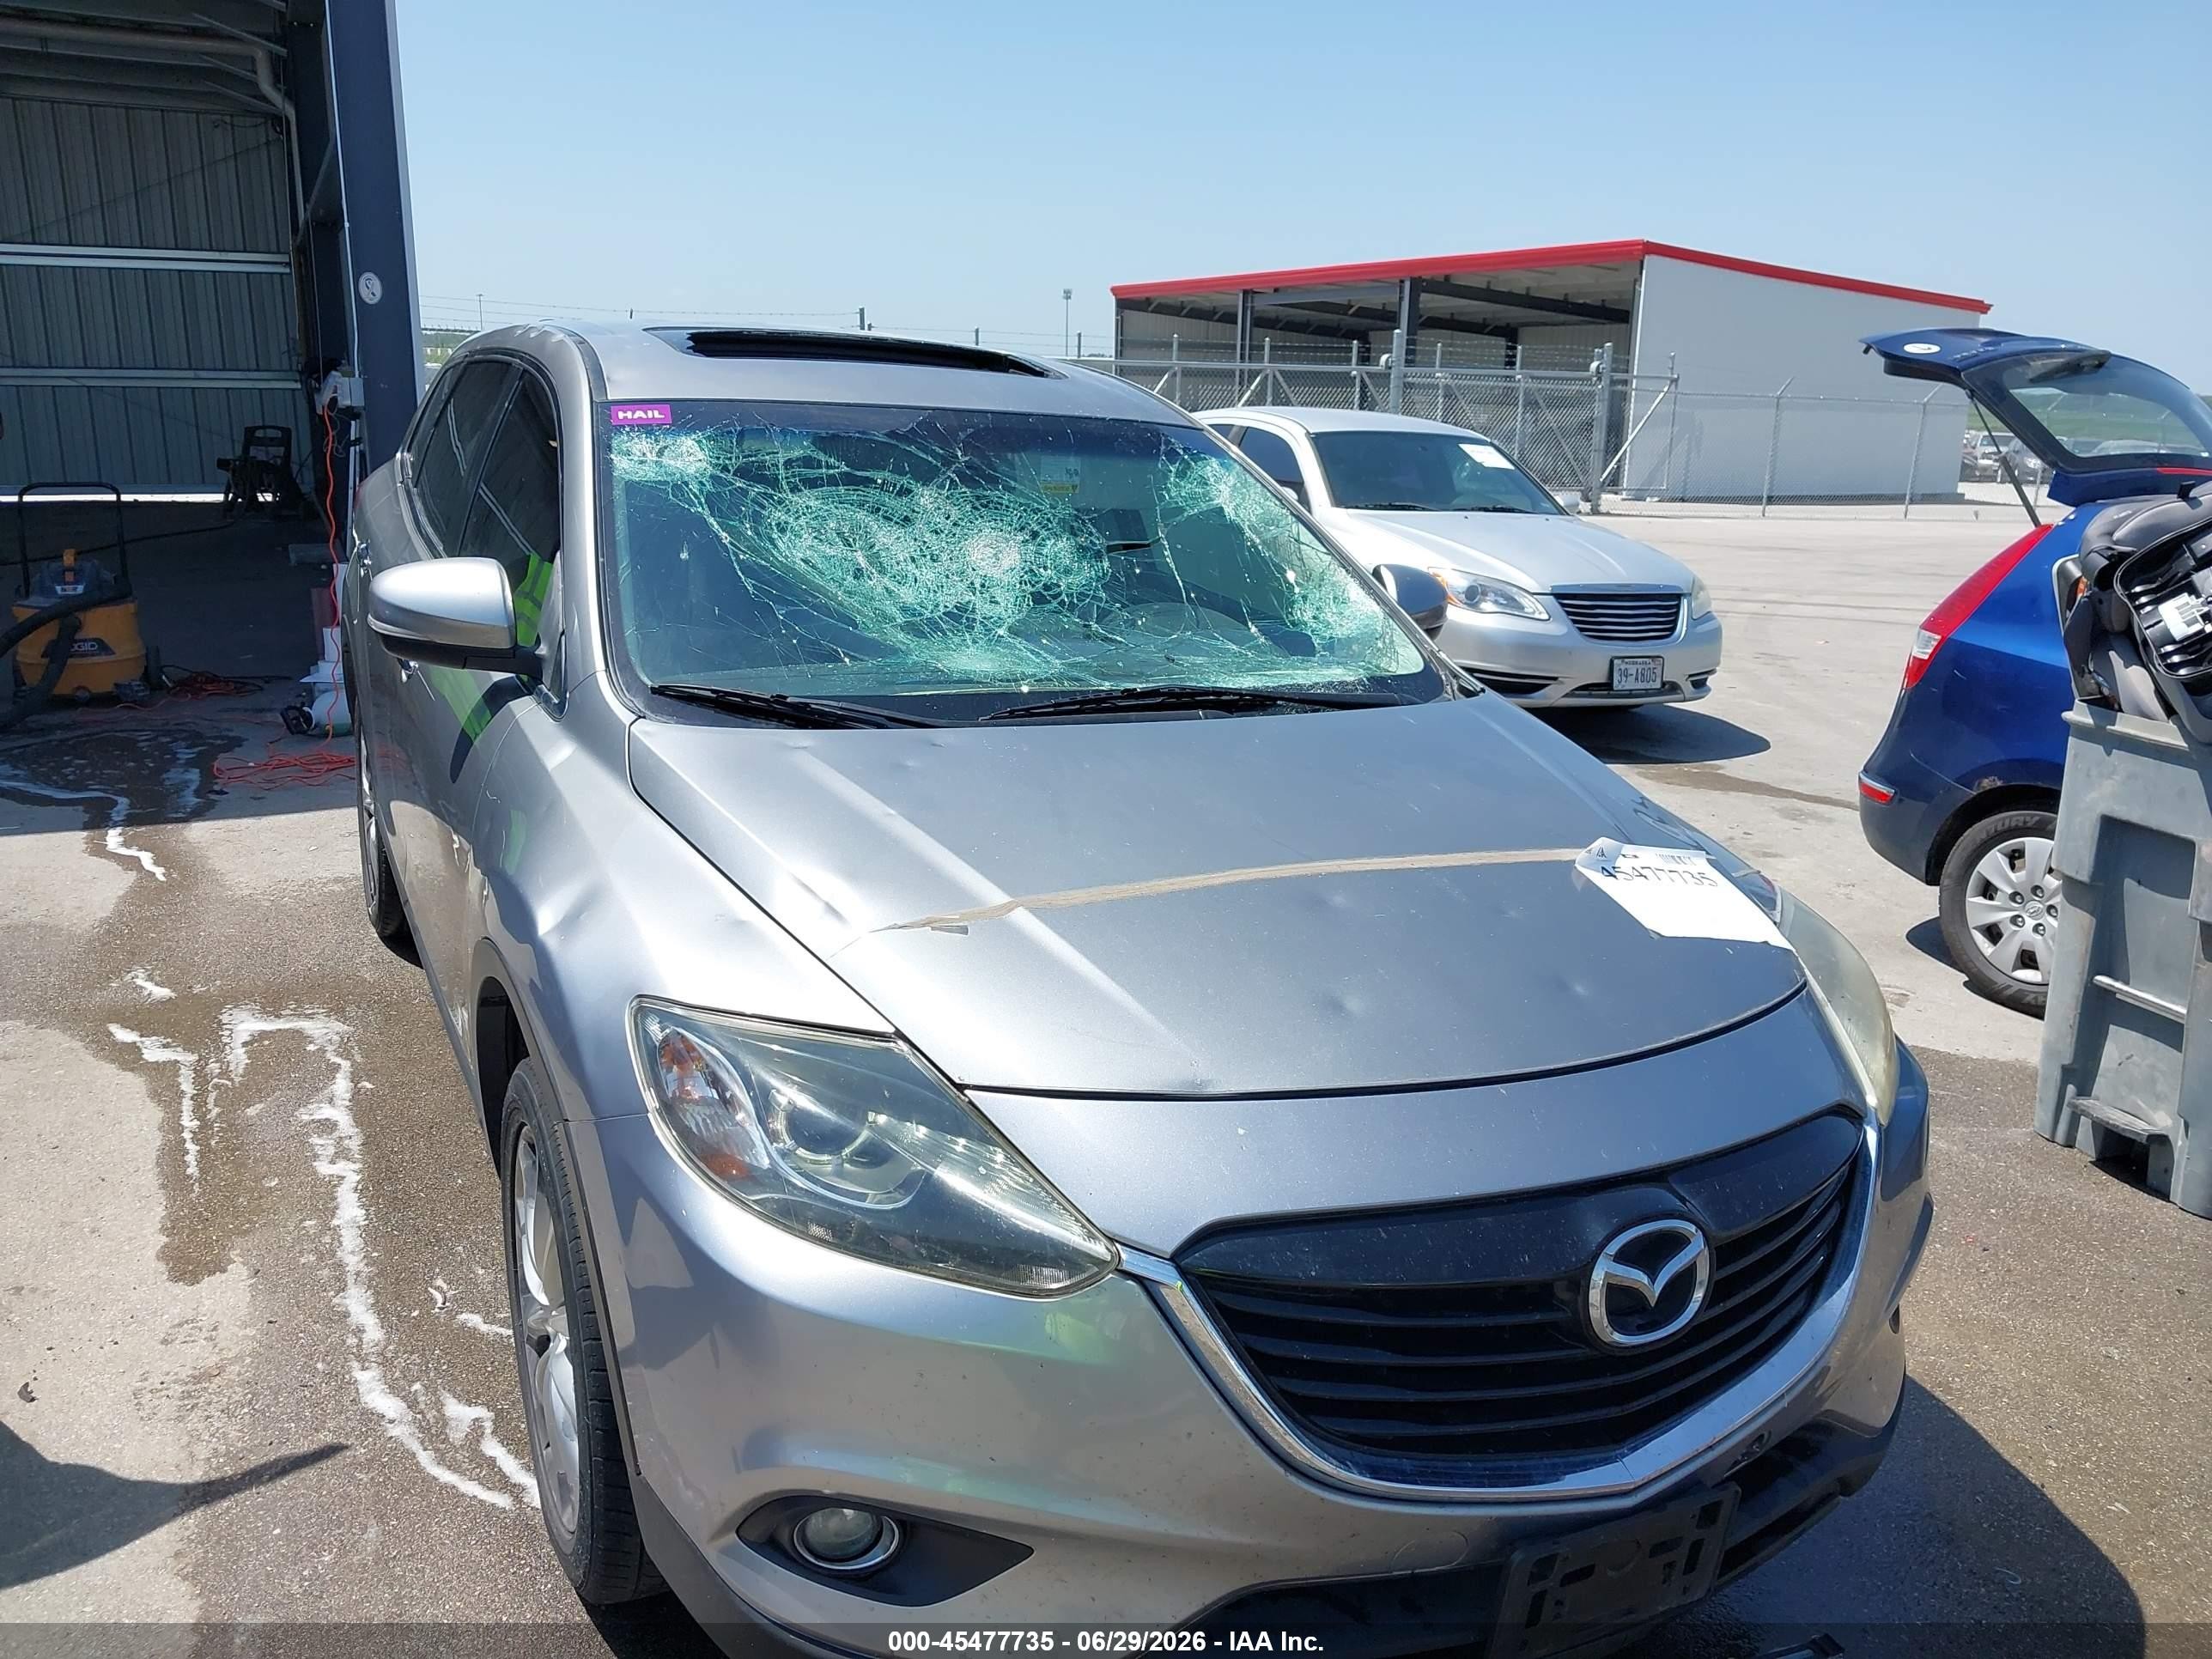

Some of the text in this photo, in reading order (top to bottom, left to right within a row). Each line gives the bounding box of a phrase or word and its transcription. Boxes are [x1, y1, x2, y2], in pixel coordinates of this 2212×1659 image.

[617, 410, 665, 420] HAIL
[1617, 667, 1657, 684] 39-A805
[1601, 866, 1718, 887] 45477735
